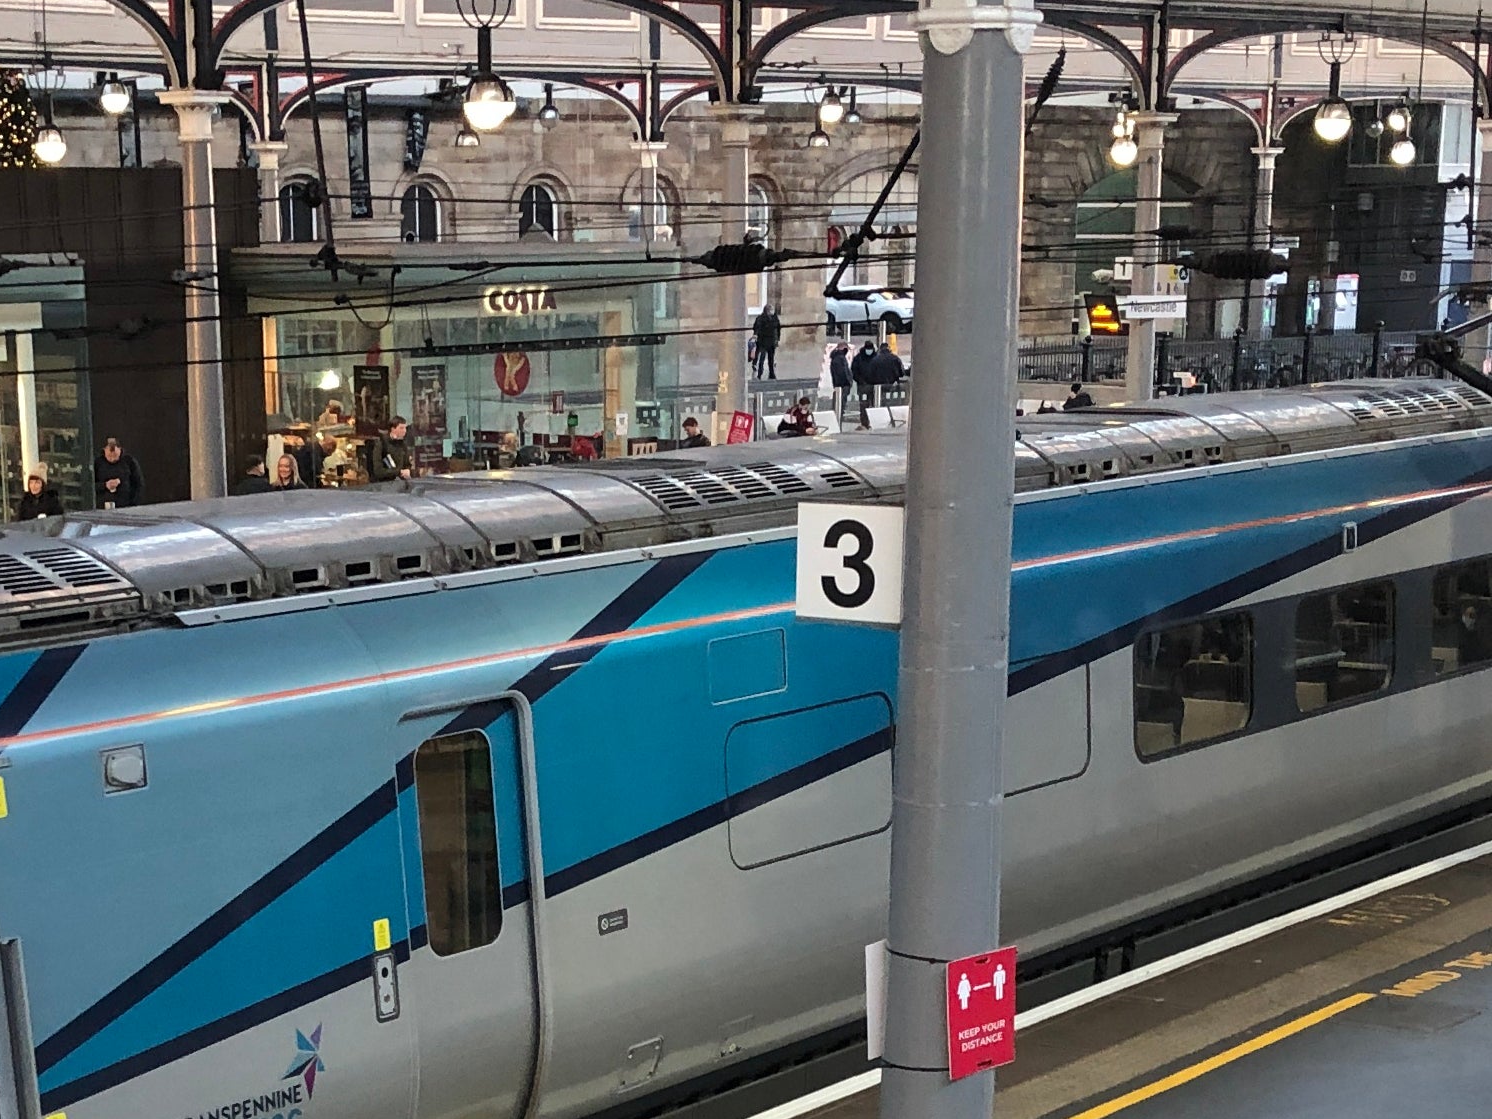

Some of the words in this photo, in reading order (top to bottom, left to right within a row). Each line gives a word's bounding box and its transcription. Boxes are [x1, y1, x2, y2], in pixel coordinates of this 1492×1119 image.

[489, 290, 558, 315] COSTA
[1130, 301, 1177, 313] Newcastle
[820, 518, 875, 608] 3
[1443, 951, 1492, 969] TH
[958, 1026, 980, 1040] KEEP
[982, 1019, 1006, 1033] YOUR
[961, 1031, 1003, 1053] DISTANCE
